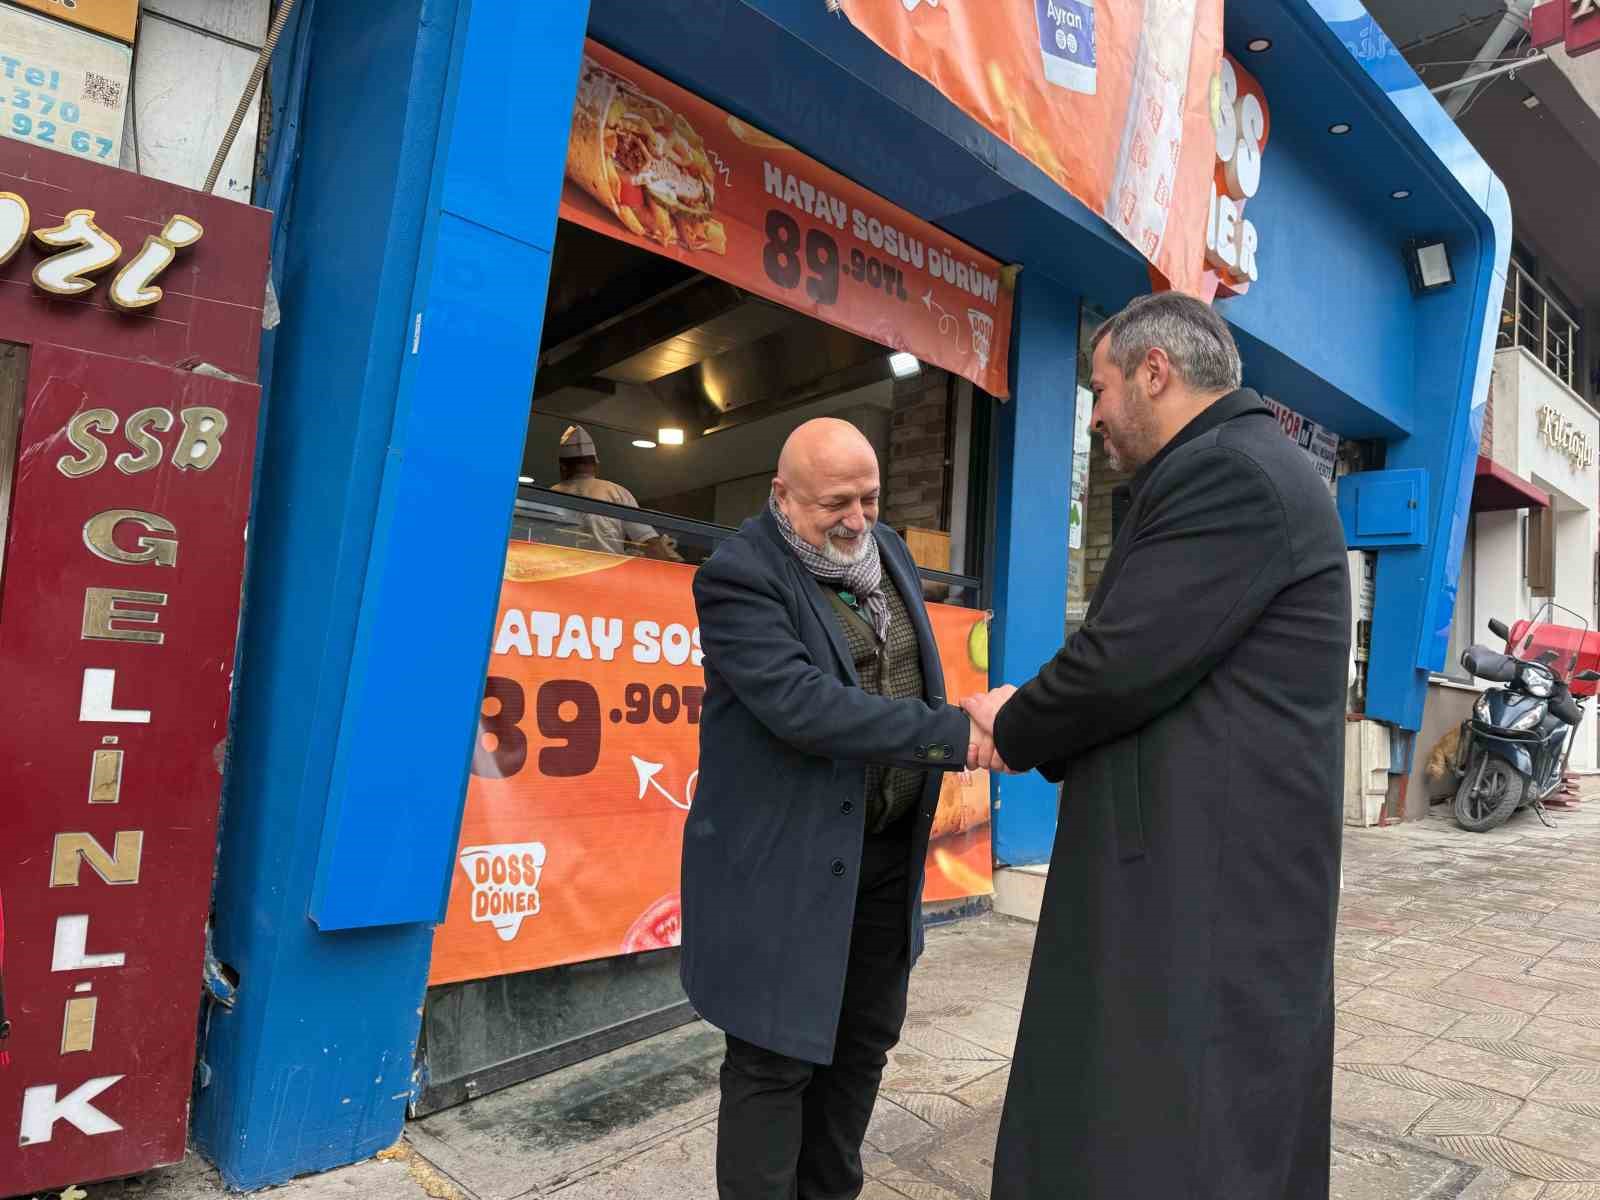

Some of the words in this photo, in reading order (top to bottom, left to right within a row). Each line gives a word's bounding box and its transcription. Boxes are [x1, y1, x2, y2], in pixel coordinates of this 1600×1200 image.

[1047, 0, 1082, 30] Ayran
[1, 56, 60, 90] Tel
[763, 160, 847, 230] HATAY
[852, 209, 924, 269] SOSLU
[928, 247, 998, 305] DÜRÜM
[57, 407, 228, 479] SSB
[495, 609, 623, 661] ATAY
[475, 853, 536, 886] DOSS
[475, 885, 537, 918] DÖNER
